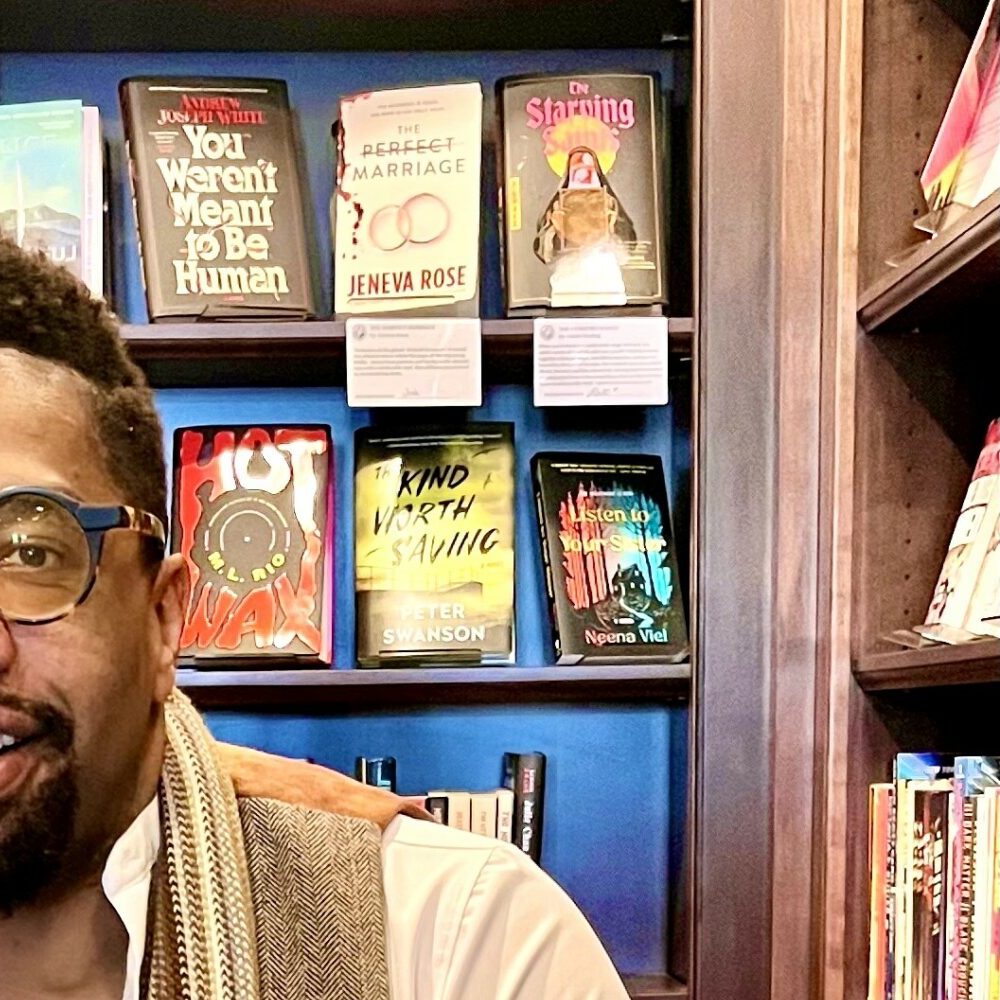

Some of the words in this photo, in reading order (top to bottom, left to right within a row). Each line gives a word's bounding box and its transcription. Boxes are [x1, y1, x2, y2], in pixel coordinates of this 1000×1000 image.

[181, 123, 247, 160] You
[396, 123, 422, 135] THE
[360, 136, 457, 159] PERFECT
[352, 158, 466, 182] MARRIAGE
[170, 191, 275, 231] Meant
[182, 228, 220, 262] to
[224, 226, 270, 261] Be
[172, 259, 290, 302] Human
[347, 270, 414, 297] JENEVA
[420, 265, 467, 289] ROSE
[397, 464, 470, 498] KIND
[570, 506, 627, 523] Listen
[391, 527, 501, 567] SAVING
[179, 570, 323, 650] WAX
[400, 602, 465, 622] PETER
[382, 624, 486, 646] SWANSON
[584, 628, 636, 648] Neena
[638, 628, 670, 644] Viel
